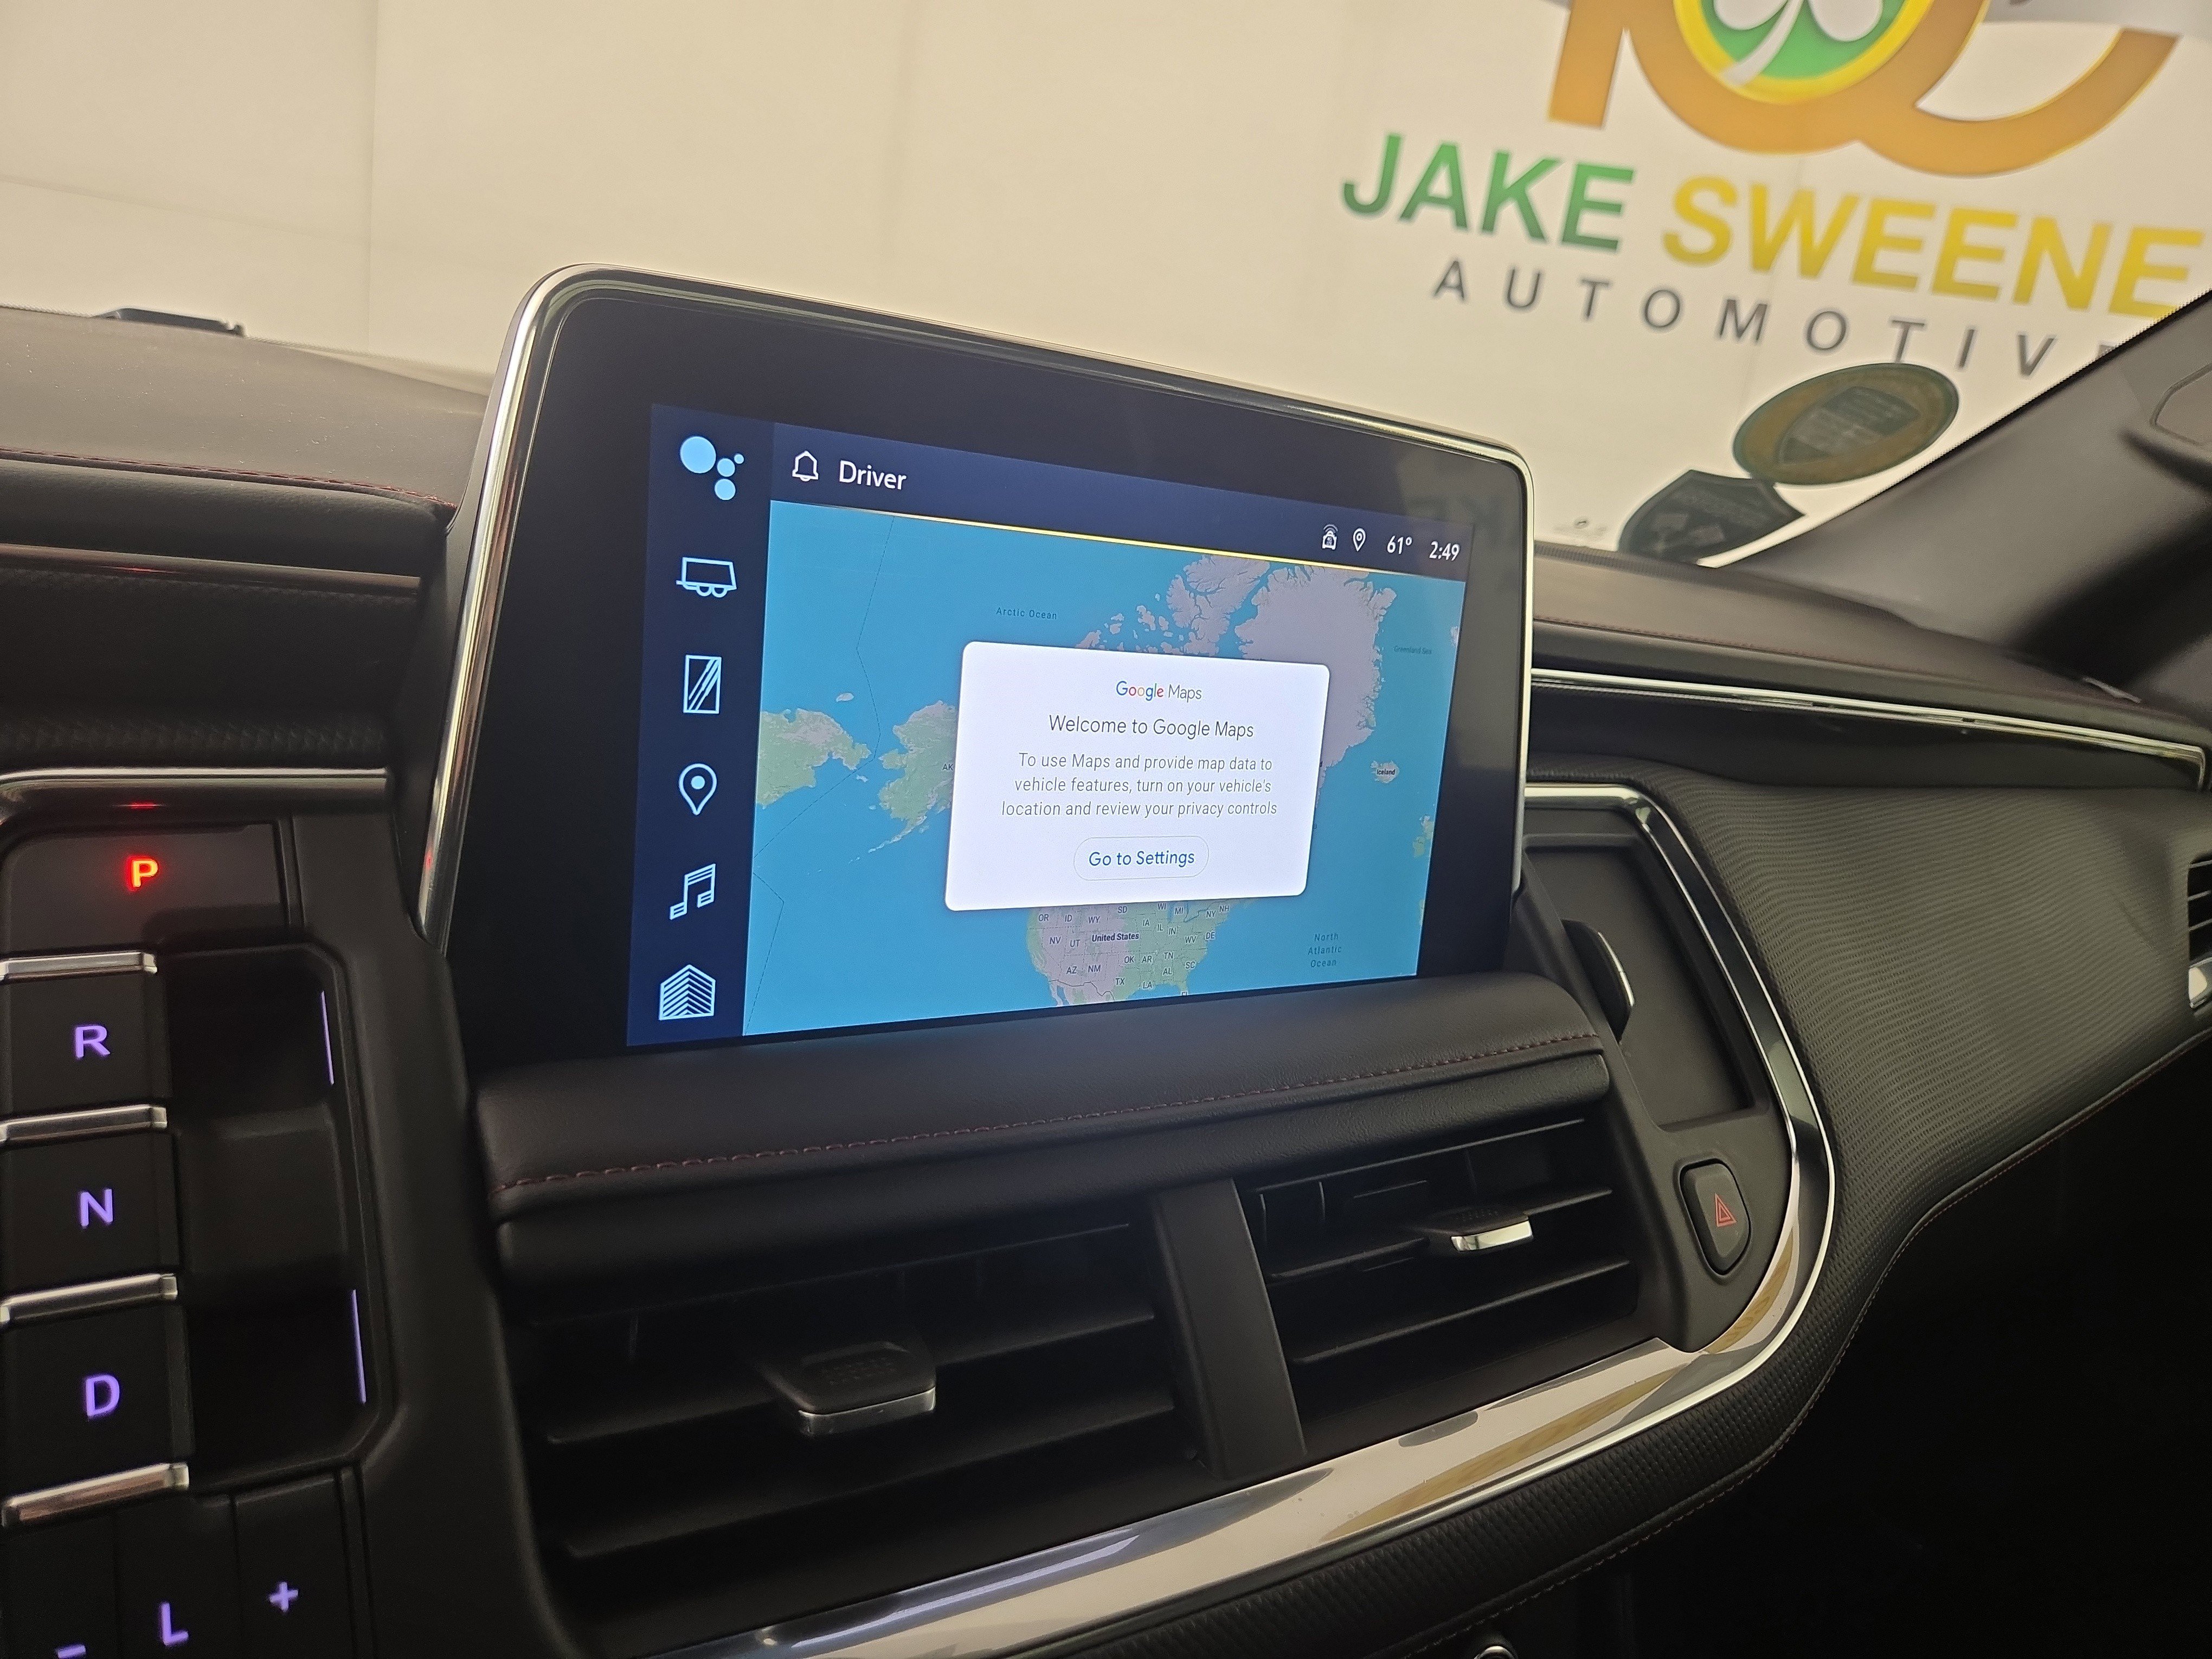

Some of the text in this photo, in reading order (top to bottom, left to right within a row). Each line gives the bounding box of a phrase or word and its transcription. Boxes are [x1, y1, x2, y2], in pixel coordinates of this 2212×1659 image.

[1341, 132, 1634, 252] JAKE
[1432, 257, 2114, 378] AUTOMOTIV
[839, 460, 907, 490] Driver
[1429, 540, 1461, 562] 2:49
[996, 607, 1057, 620] Arctic Ocean
[1116, 680, 1202, 703] Google Maps
[1049, 714, 1254, 741] Welcome to Google Maps
[1019, 752, 1272, 773] To use Maps and provide map data to
[1014, 776, 1271, 796] vehicle features, turn on your vehicle's
[1001, 801, 1278, 819] location and review your privacy controls
[1089, 850, 1195, 868] Go to Settings
[129, 857, 159, 890] P
[1174, 907, 1184, 915] MI
[1206, 910, 1217, 918] NY
[1038, 914, 1049, 922] OR
[1064, 914, 1073, 922] ID
[1088, 916, 1101, 924] WY
[1092, 933, 1140, 942] United States
[1185, 936, 1197, 944] WV
[1206, 931, 1216, 940] DE
[1314, 933, 1339, 942] North
[1049, 936, 1062, 945] NV
[1070, 939, 1081, 948] UT
[1307, 946, 1342, 955] Atlantic
[1124, 955, 1135, 964] OK
[1141, 955, 1152, 963] AR
[1163, 951, 1174, 960] TN
[1185, 961, 1195, 969] SC
[1310, 959, 1337, 968] Ocean
[1066, 966, 1077, 975] AZ
[1088, 964, 1101, 973] NM
[1115, 977, 1126, 986] TX
[74, 1024, 111, 1060] R
[79, 1188, 114, 1229] N
[85, 1373, 120, 1420] D
[159, 1602, 189, 1647] L
